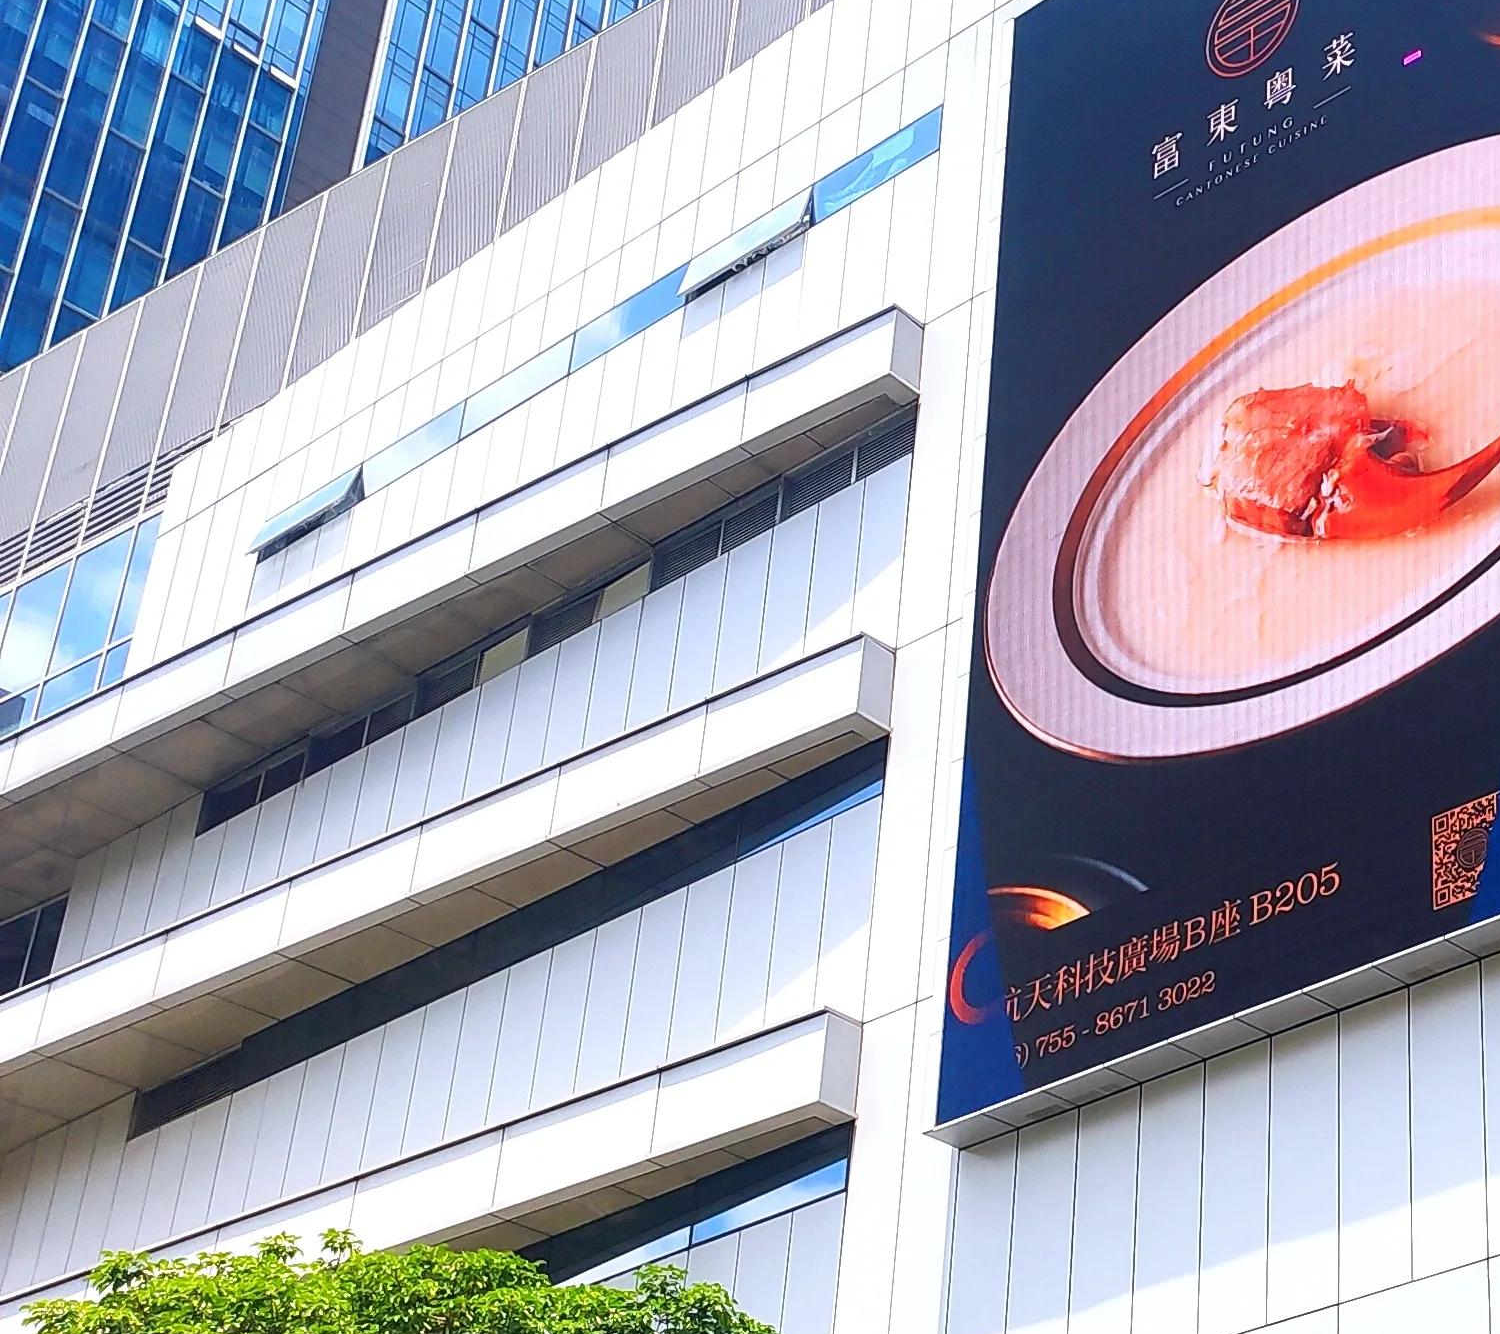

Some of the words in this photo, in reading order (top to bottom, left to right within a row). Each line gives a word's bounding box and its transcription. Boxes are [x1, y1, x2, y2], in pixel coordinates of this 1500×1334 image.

[1175, 153, 1260, 207] CANTONESE
[1267, 115, 1328, 155] CUISINE
[1248, 861, 1341, 926] B205
[1035, 1024, 1076, 1058] 755
[1094, 996, 1150, 1036] 8671
[1156, 971, 1216, 1011] 3022
